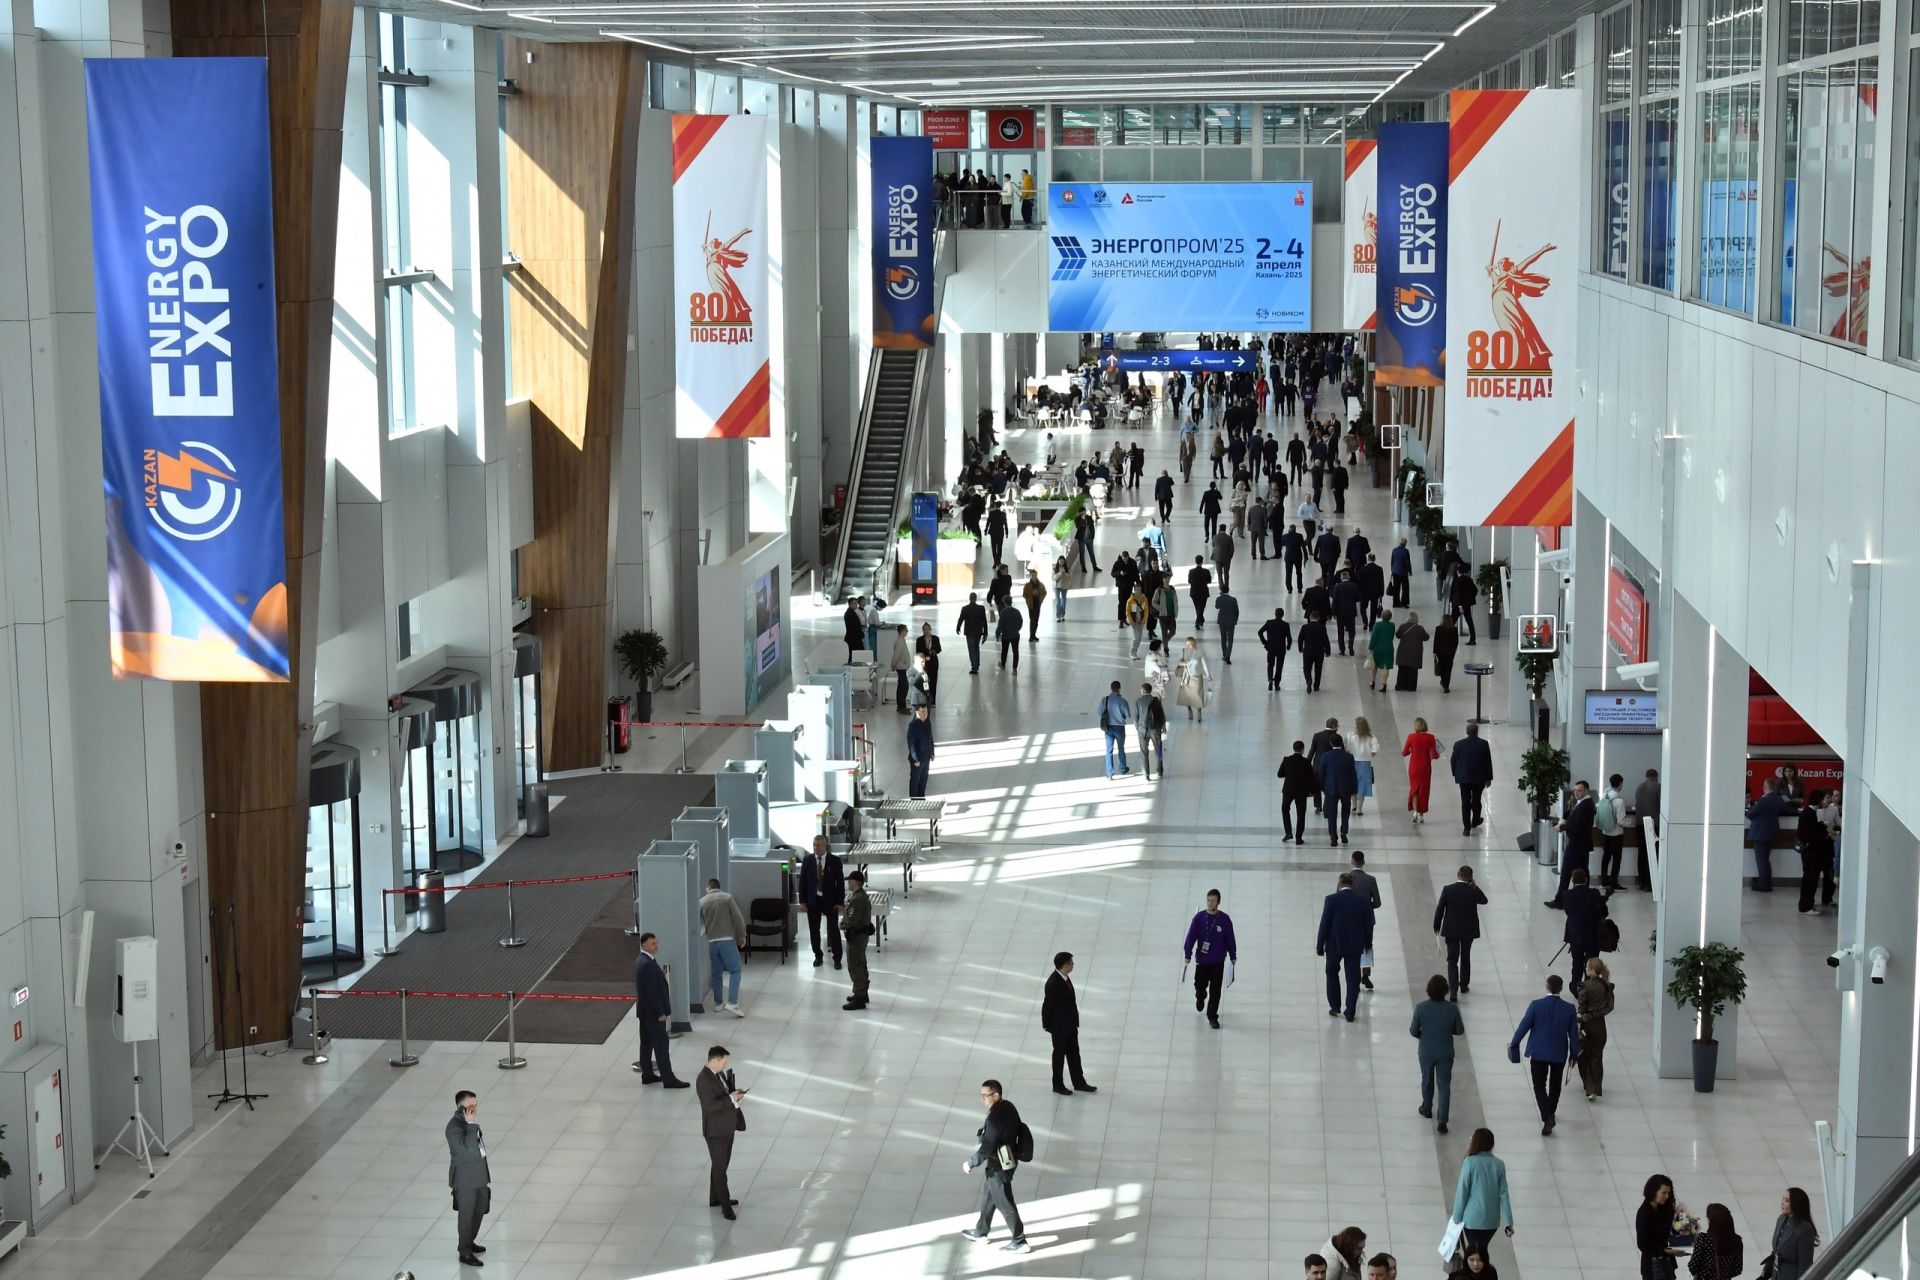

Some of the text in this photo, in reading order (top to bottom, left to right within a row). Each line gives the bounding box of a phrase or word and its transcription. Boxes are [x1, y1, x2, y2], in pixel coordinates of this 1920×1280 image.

[889, 184, 919, 258] EXPO
[1400, 183, 1437, 273] EXPO
[1353, 243, 1375, 261] 80
[1091, 258, 1245, 269] КАЗАНСКИЙ МЕЖДУНАРОДНЫЙ
[1091, 268, 1217, 278] ЭНЕРГЕТИЧЕСКИЙ ФОРУМ
[1256, 261, 1302, 272] апреля
[1353, 264, 1376, 274] ПОБЕ
[151, 205, 234, 416] EXPO
[690, 292, 724, 322] 80
[690, 327, 753, 345] ПОБЕДА!
[1467, 330, 1514, 370] 80
[1466, 377, 1553, 401] ПОБЕДА!
[144, 449, 158, 507] KAZAN
[1797, 768, 1843, 780] Kazan Exp
